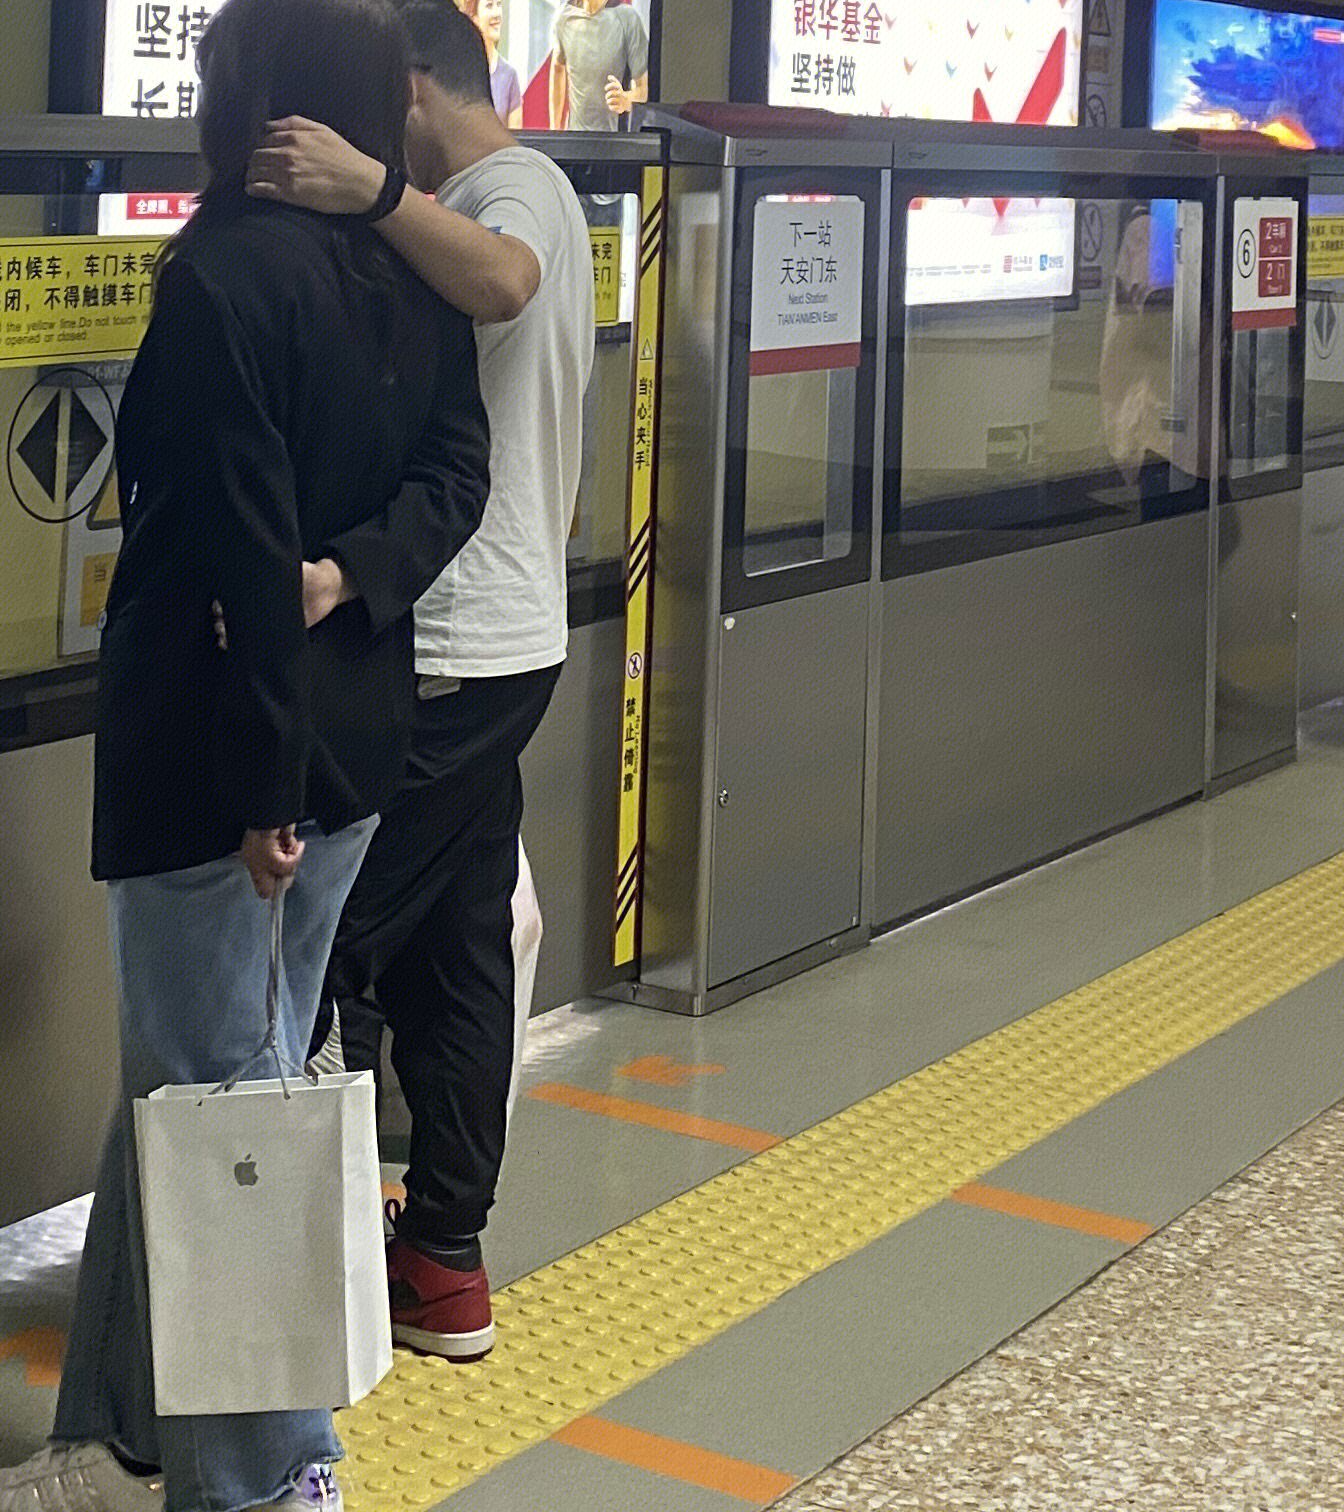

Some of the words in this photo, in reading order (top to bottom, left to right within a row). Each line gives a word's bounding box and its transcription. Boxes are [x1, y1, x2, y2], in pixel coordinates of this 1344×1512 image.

[791, 52, 856, 96] 坚持做
[789, 220, 832, 248] 下一站
[1242, 239, 1250, 266] 6
[780, 255, 837, 285] 天安门东
[6, 321, 22, 333] the
[26, 320, 56, 334] yellow
[6, 333, 41, 346] opened
[635, 376, 648, 471] 当心夹手
